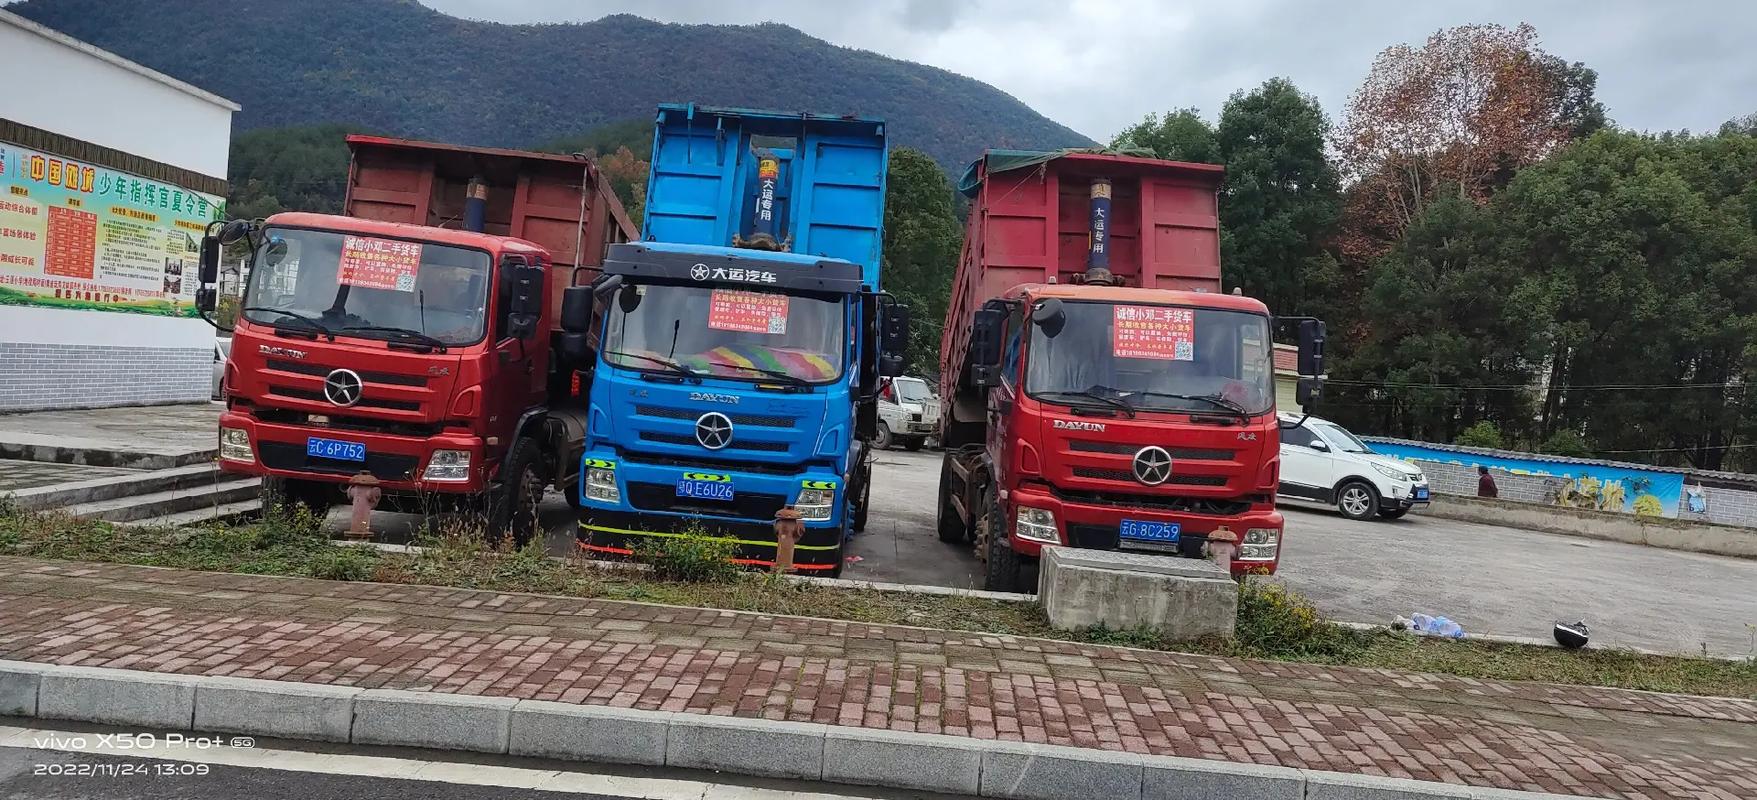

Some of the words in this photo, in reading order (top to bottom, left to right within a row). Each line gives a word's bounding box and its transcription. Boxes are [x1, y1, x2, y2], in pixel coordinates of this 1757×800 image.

[760, 178, 775, 221] 大运专用
[1092, 207, 1105, 254] 大运专用
[345, 237, 420, 257] 诚信小邓二手货车
[711, 267, 777, 283] 大运汽车
[1116, 307, 1192, 323] 诚信小邓二手货车
[689, 391, 740, 404] DAYUN
[1053, 419, 1105, 432] DAYUN
